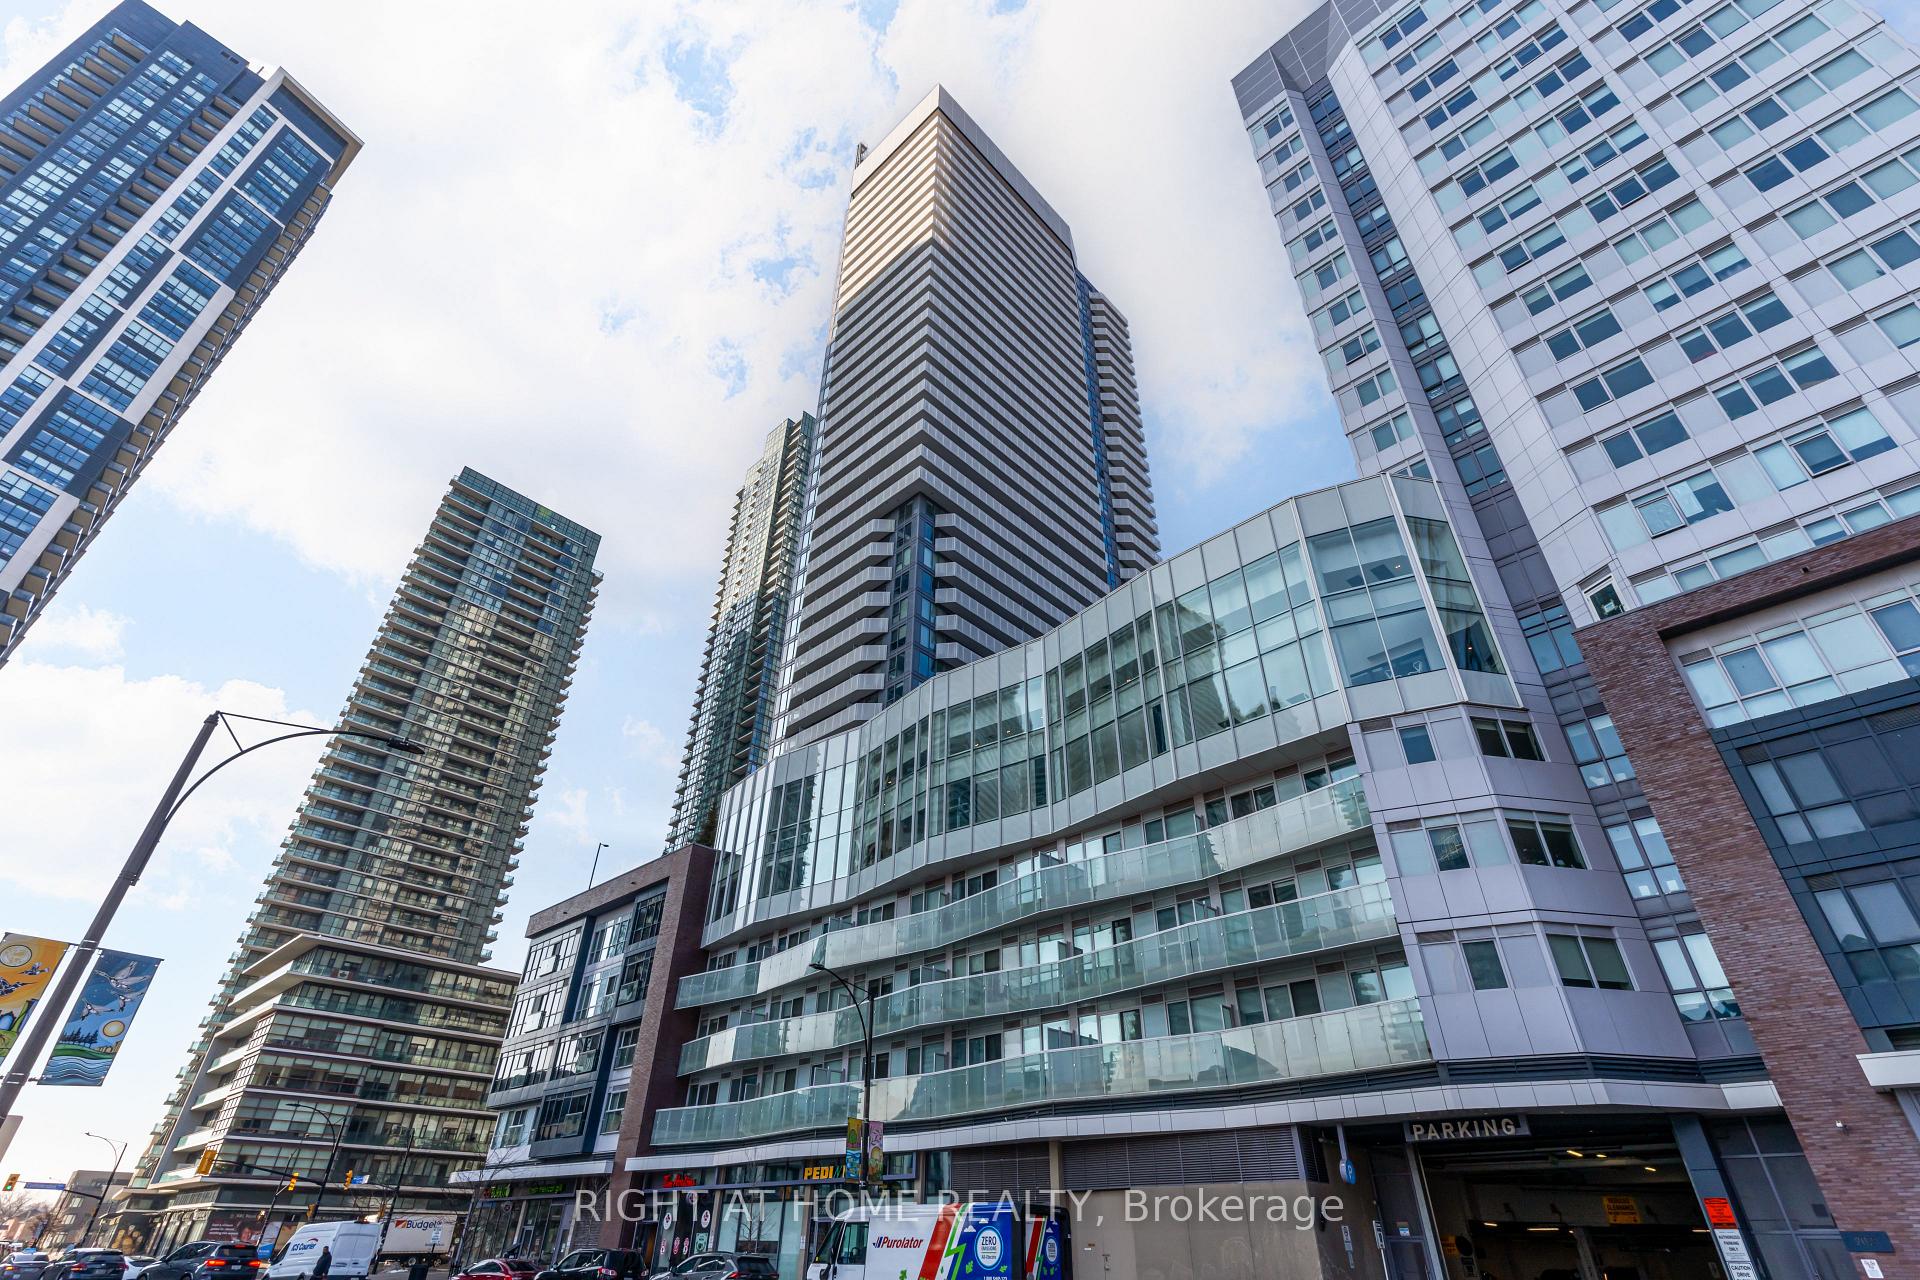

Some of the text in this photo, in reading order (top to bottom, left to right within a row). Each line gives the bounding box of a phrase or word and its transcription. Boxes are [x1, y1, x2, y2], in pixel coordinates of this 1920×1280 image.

[1412, 1118, 1516, 1140] PARKING
[803, 1165, 834, 1181] PEDI
[406, 1219, 436, 1231] Budget
[880, 1236, 924, 1249] Purolator
[981, 1236, 997, 1246] ZERO
